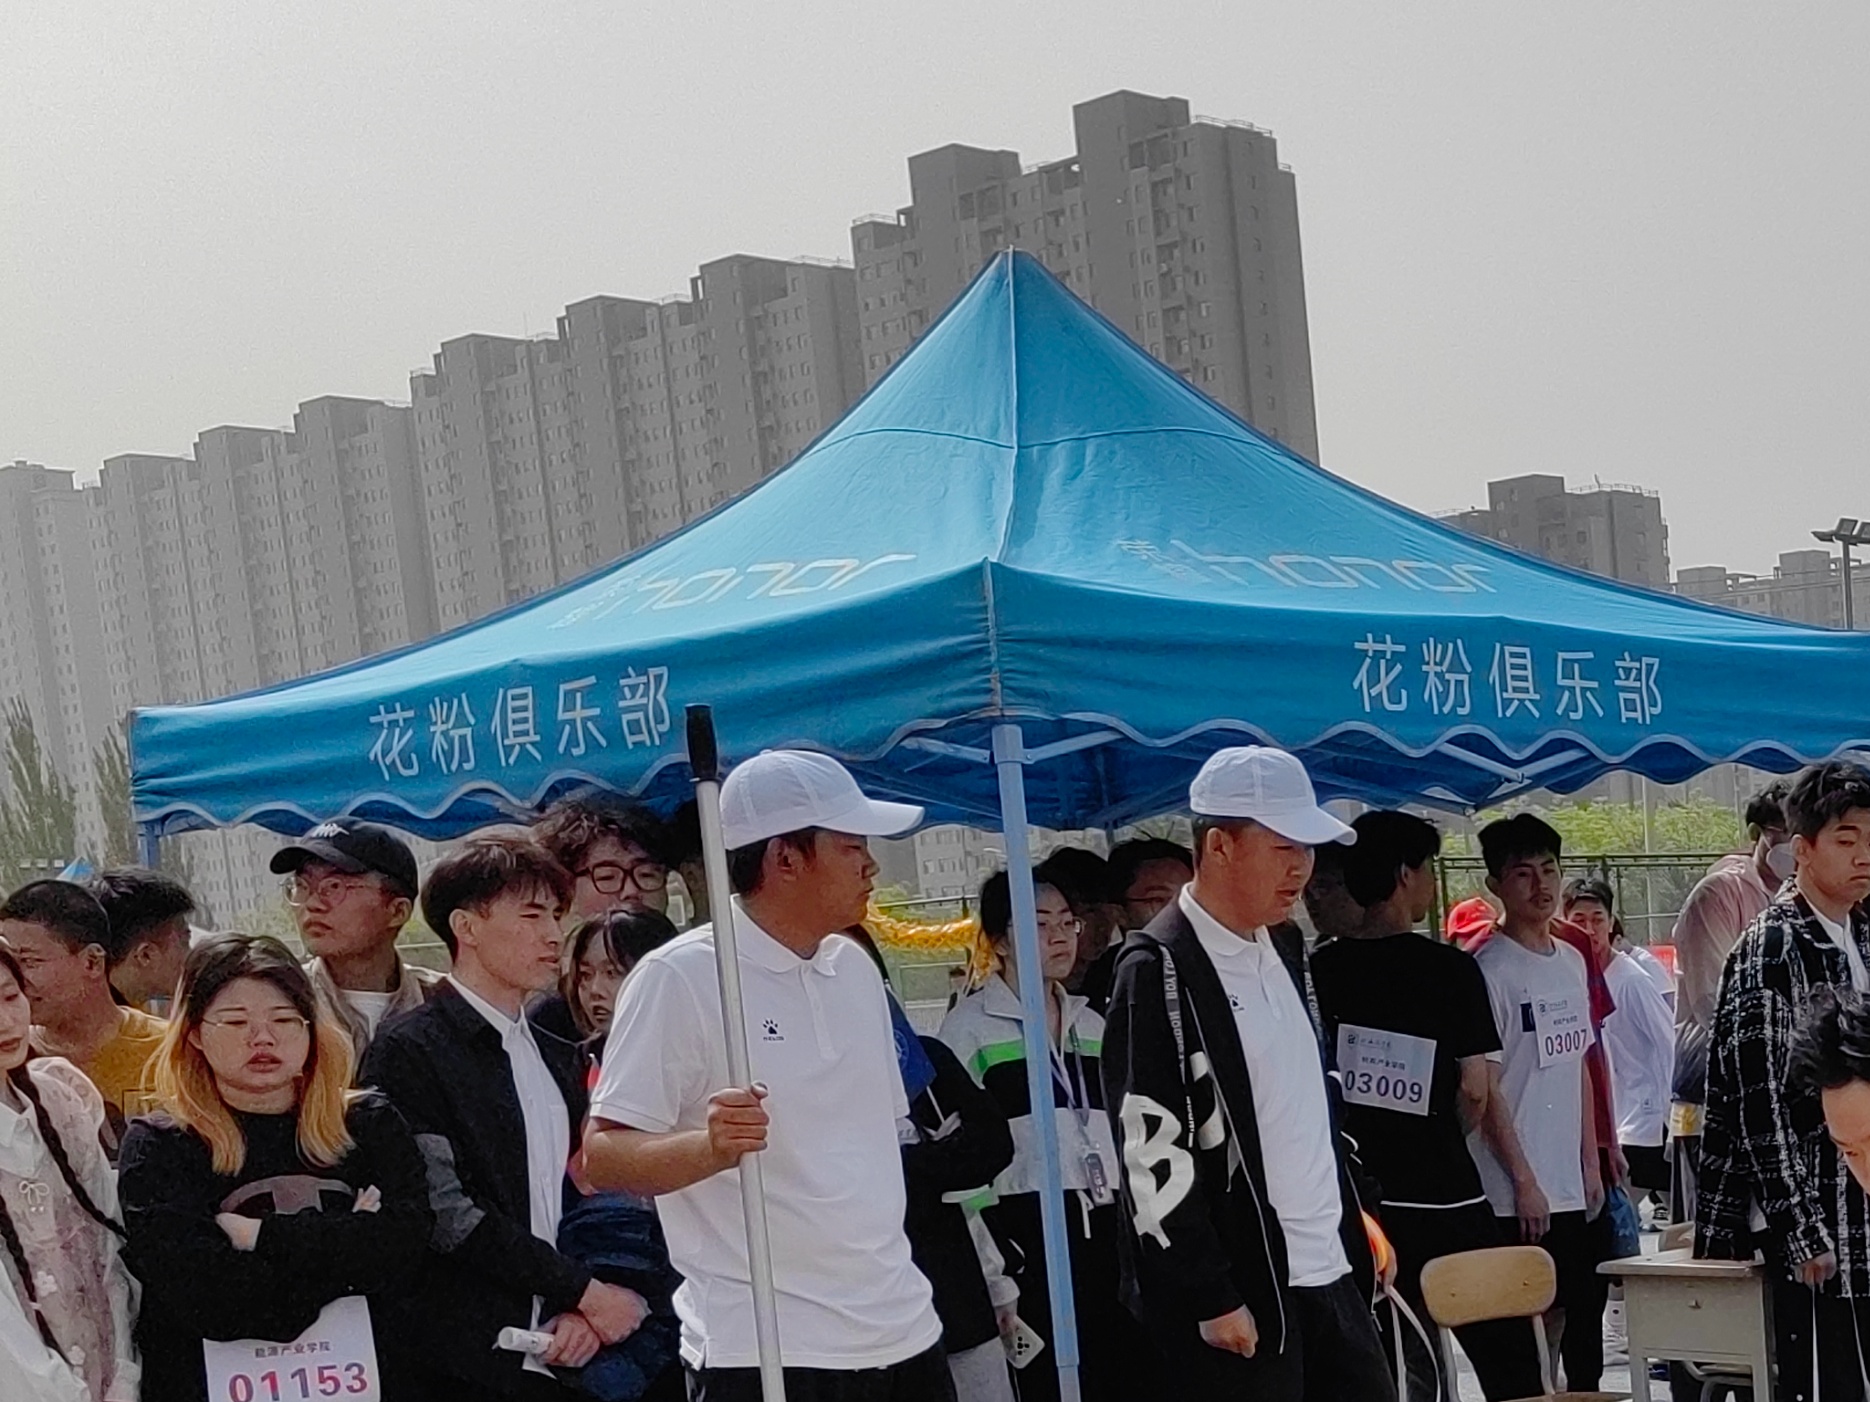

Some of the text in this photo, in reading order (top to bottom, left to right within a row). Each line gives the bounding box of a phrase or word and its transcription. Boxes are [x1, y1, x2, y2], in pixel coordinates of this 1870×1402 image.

[1351, 632, 1664, 725] 花粉俱乐部
[368, 664, 672, 782] 花粉俱乐部
[1545, 1029, 1587, 1057] 03007
[1344, 1069, 1423, 1104] 03009
